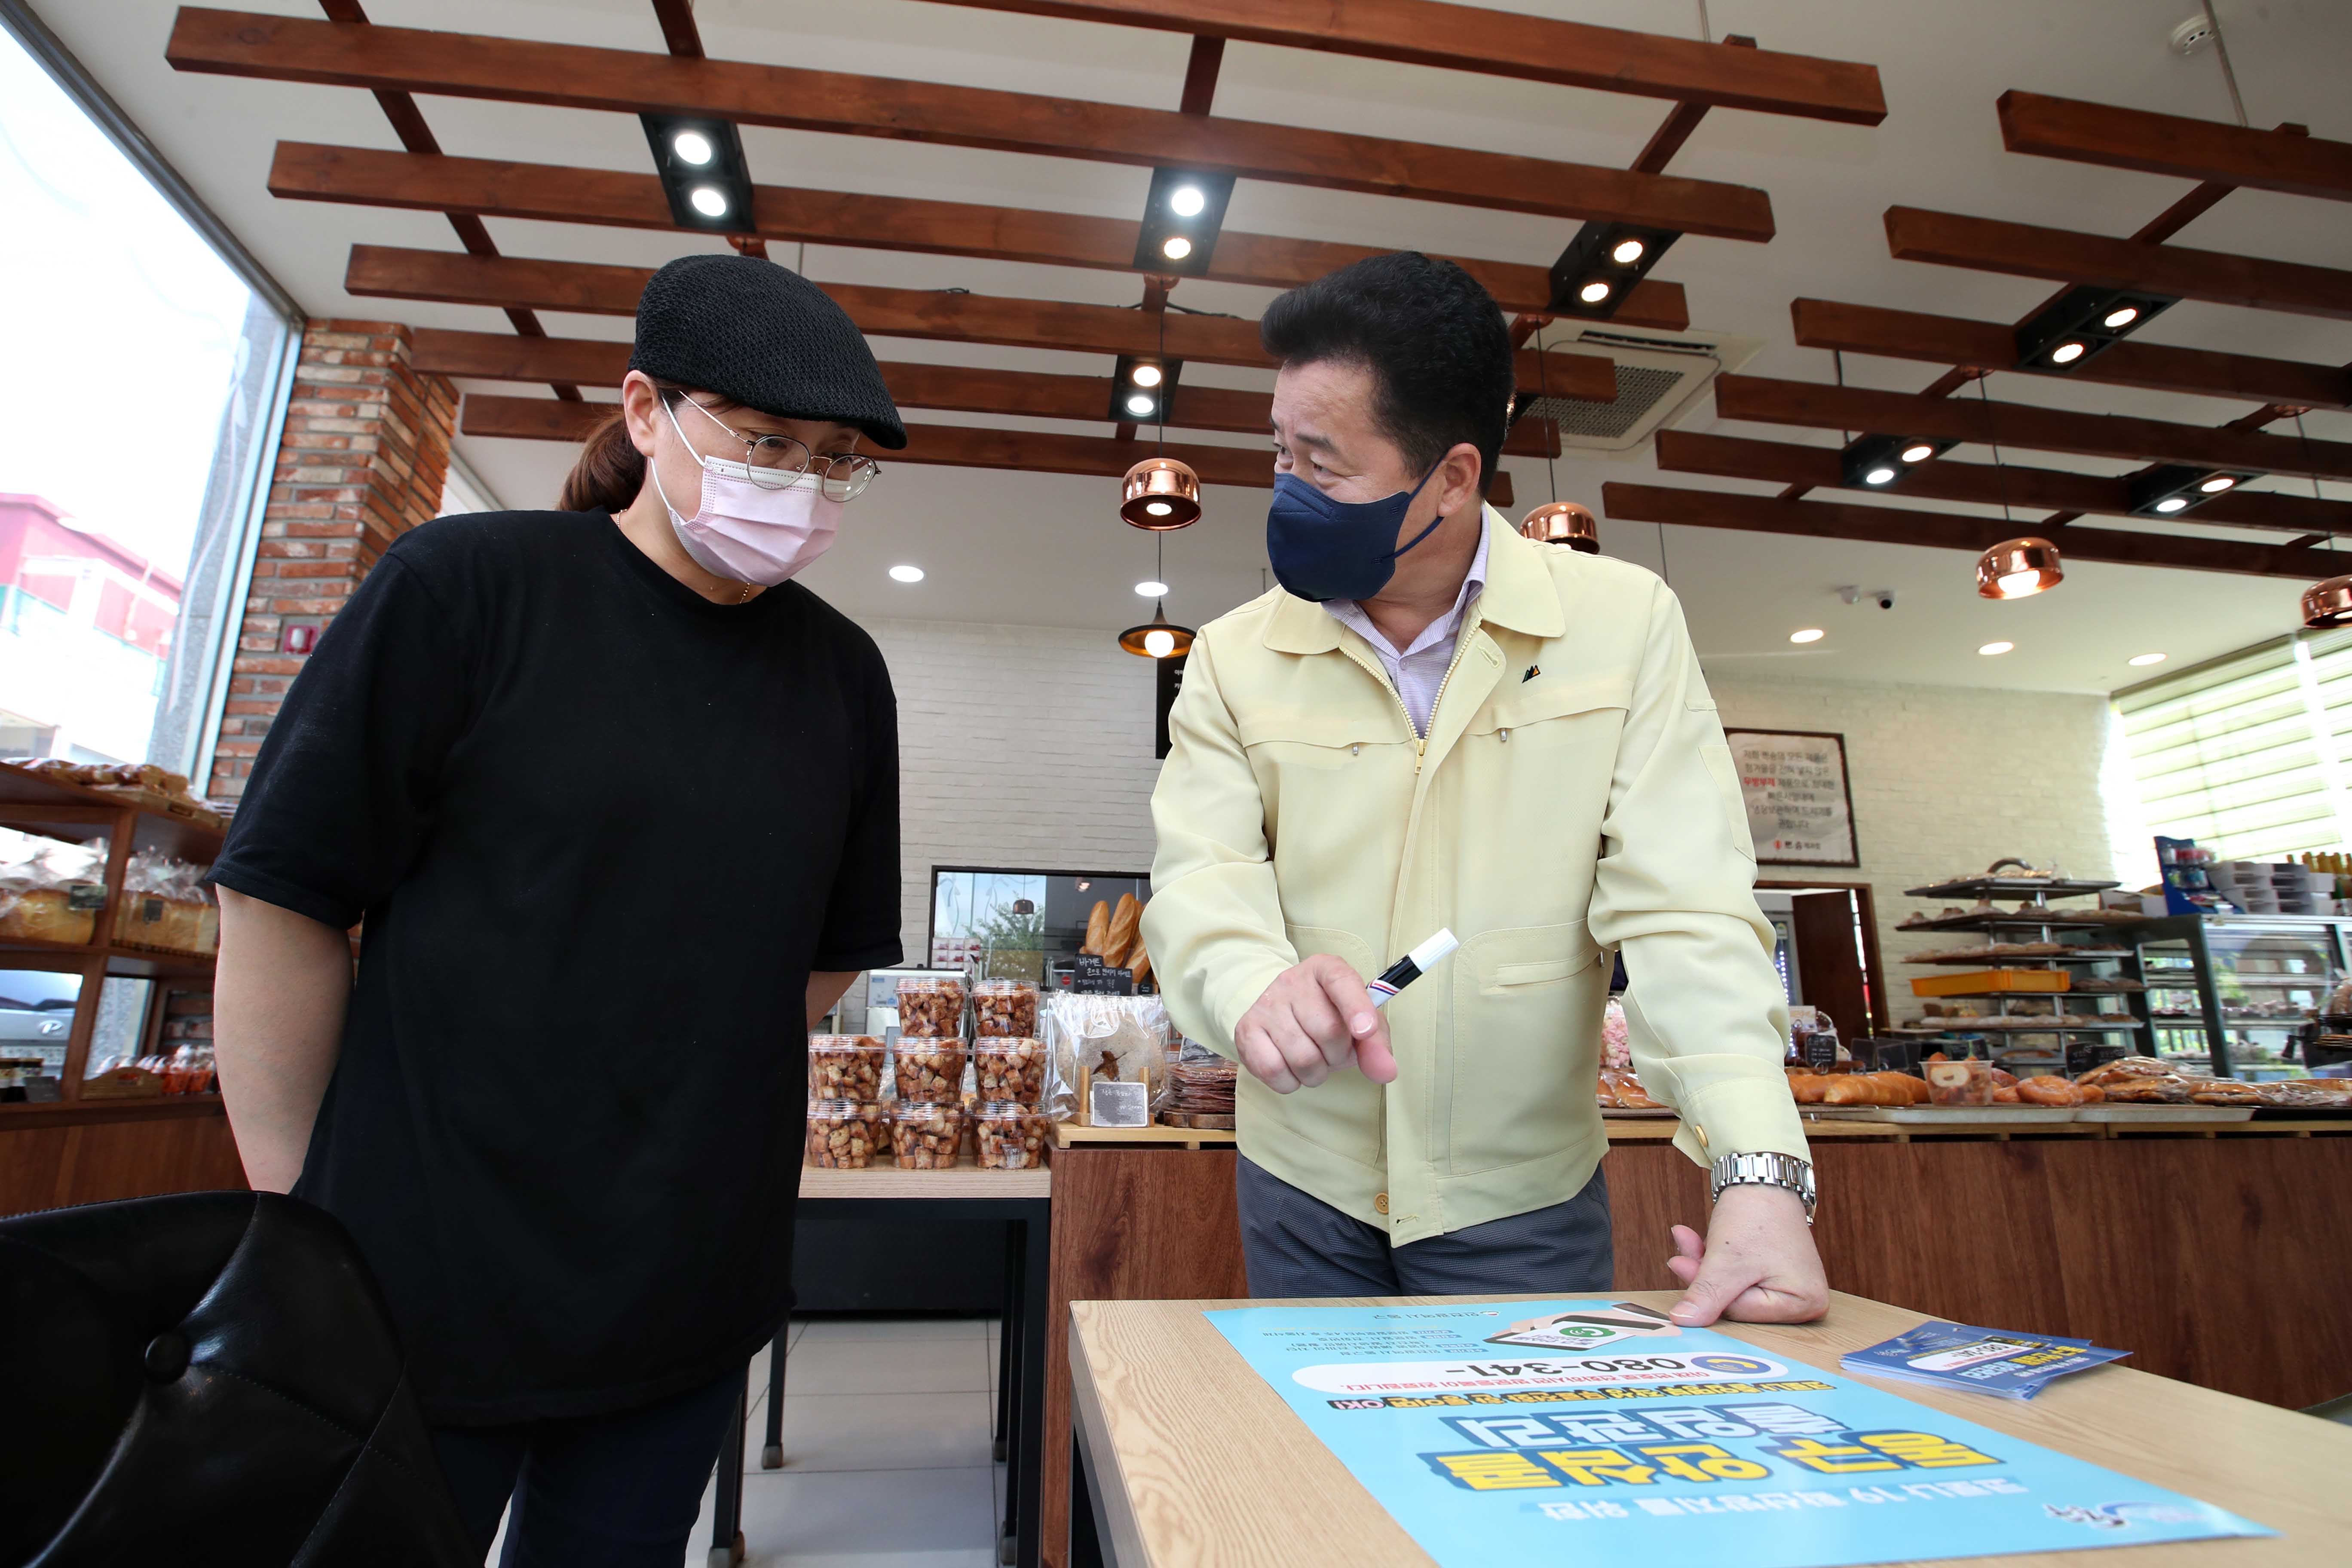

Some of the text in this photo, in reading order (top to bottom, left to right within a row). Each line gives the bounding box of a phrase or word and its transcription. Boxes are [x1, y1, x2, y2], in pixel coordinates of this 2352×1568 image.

[1339, 1381, 1436, 1392] 완료됩니다.
[1439, 1378, 1530, 1388] 방문등록이
[1531, 1375, 1617, 1384] 전화하시면
[1329, 1381, 1835, 1410] 코로나 출입명부 작성 무료전화 한 통이면 OK!
[1451, 1403, 1850, 1448] 출입관리
[1427, 1430, 2005, 1492] 동구 안심콜
[1537, 1478, 2029, 1521] 코로나 19 확산방지를 위한
